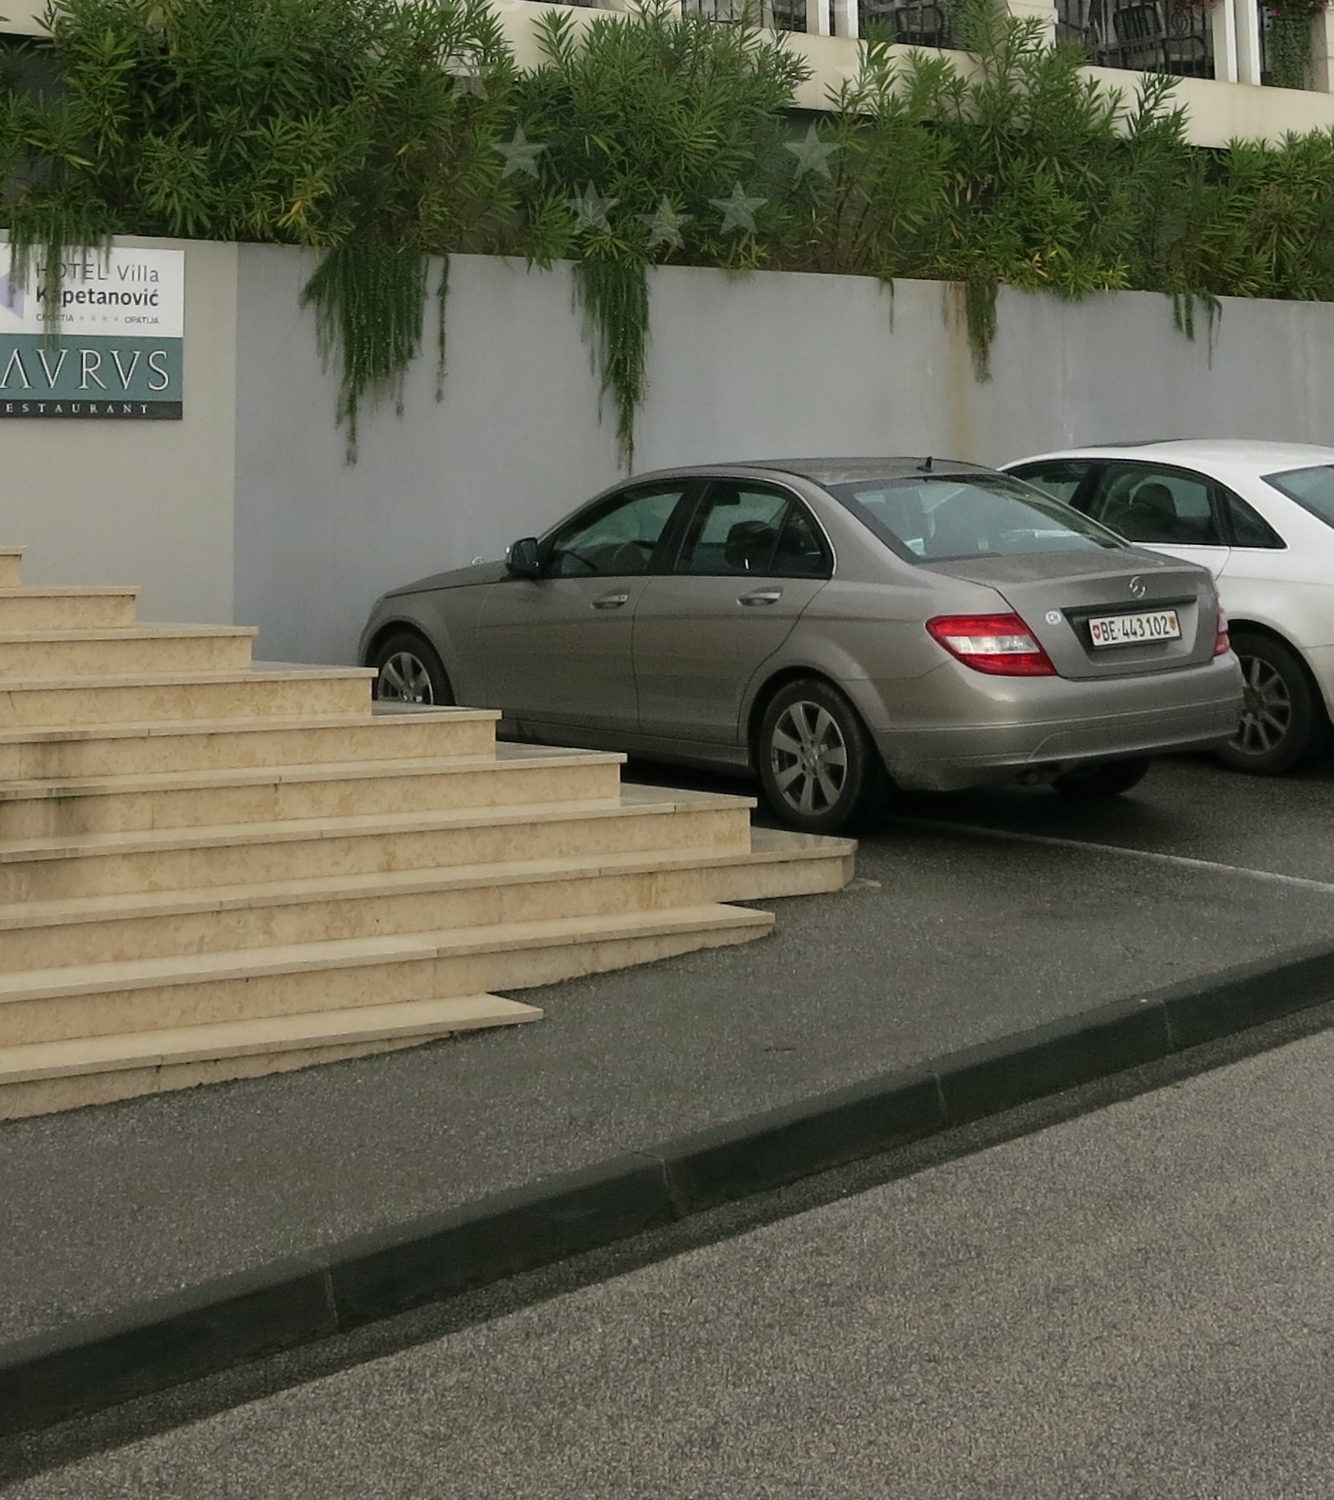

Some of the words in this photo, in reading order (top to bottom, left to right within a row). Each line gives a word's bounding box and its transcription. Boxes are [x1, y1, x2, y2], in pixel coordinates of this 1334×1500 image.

[117, 264, 159, 283] Villa
[36, 286, 159, 306] Kpetanović
[124, 316, 159, 325] OPATIJA
